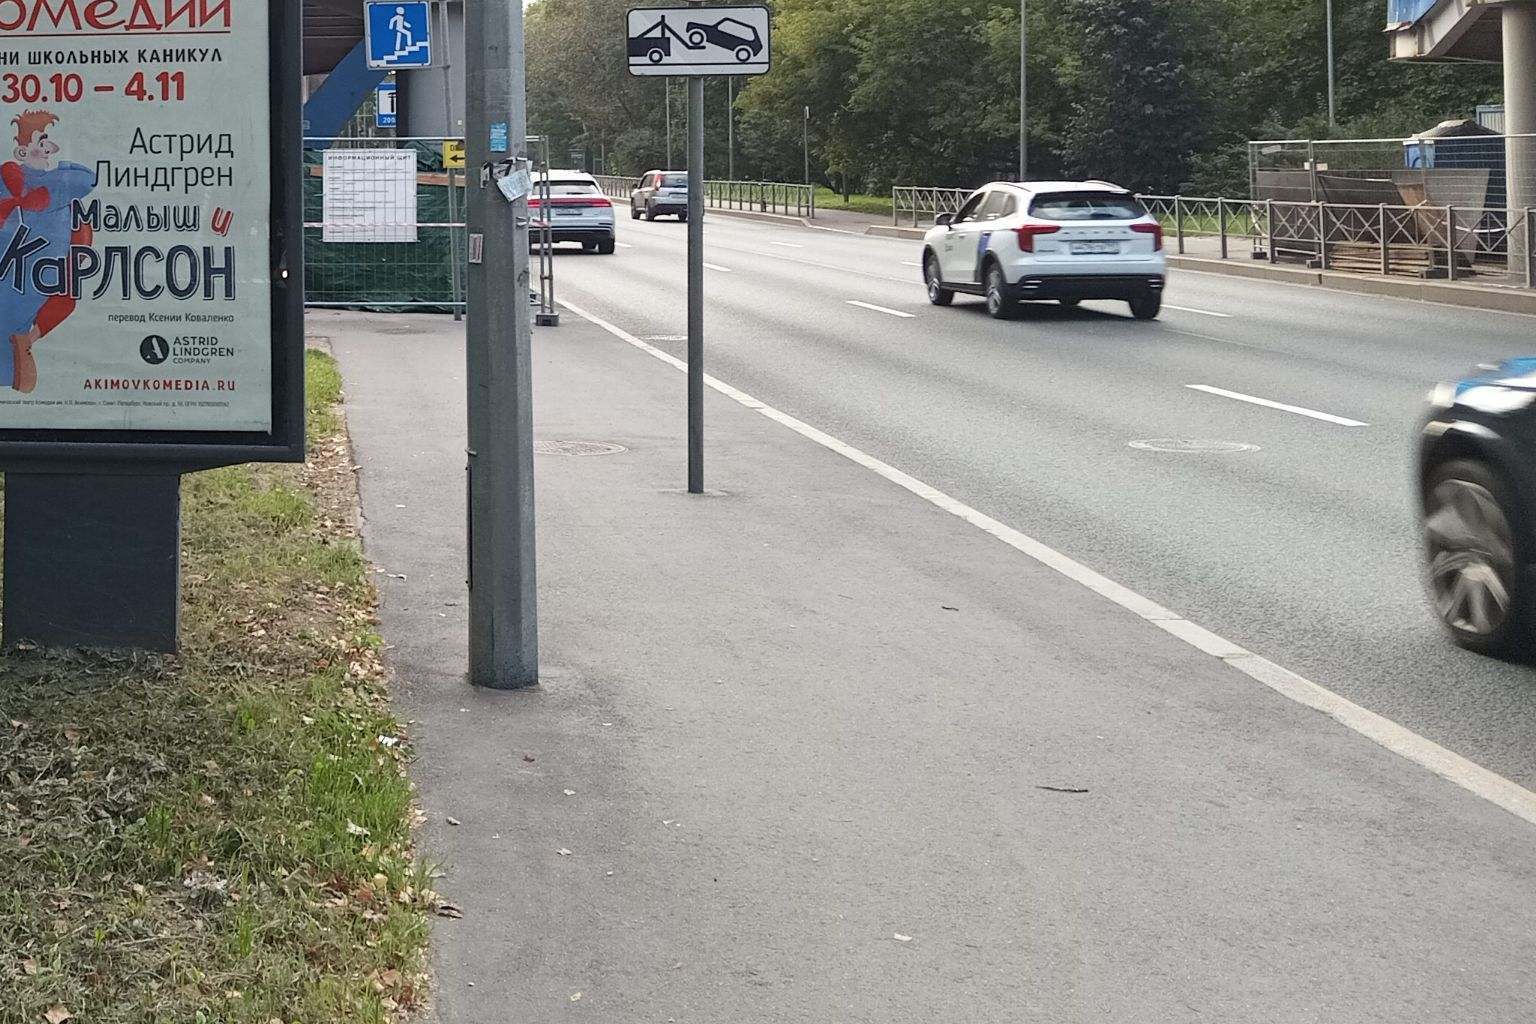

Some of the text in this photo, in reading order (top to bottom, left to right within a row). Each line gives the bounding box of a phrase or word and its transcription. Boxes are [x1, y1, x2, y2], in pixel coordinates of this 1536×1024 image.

[28, 49, 129, 65] ШКОЛЬНЫХ
[138, 48, 222, 63] КАНИКУЛ
[1, 72, 83, 104] 30.10
[124, 71, 185, 102] 4.11
[129, 127, 234, 161] Астрид
[91, 160, 233, 194] Линдгрен
[108, 312, 234, 324] перевод Ксении Коваленко
[173, 336, 219, 346] ASTRID
[173, 347, 234, 357] LINDGREN
[83, 379, 236, 391] AKIMOVKOMEDIA.RU
